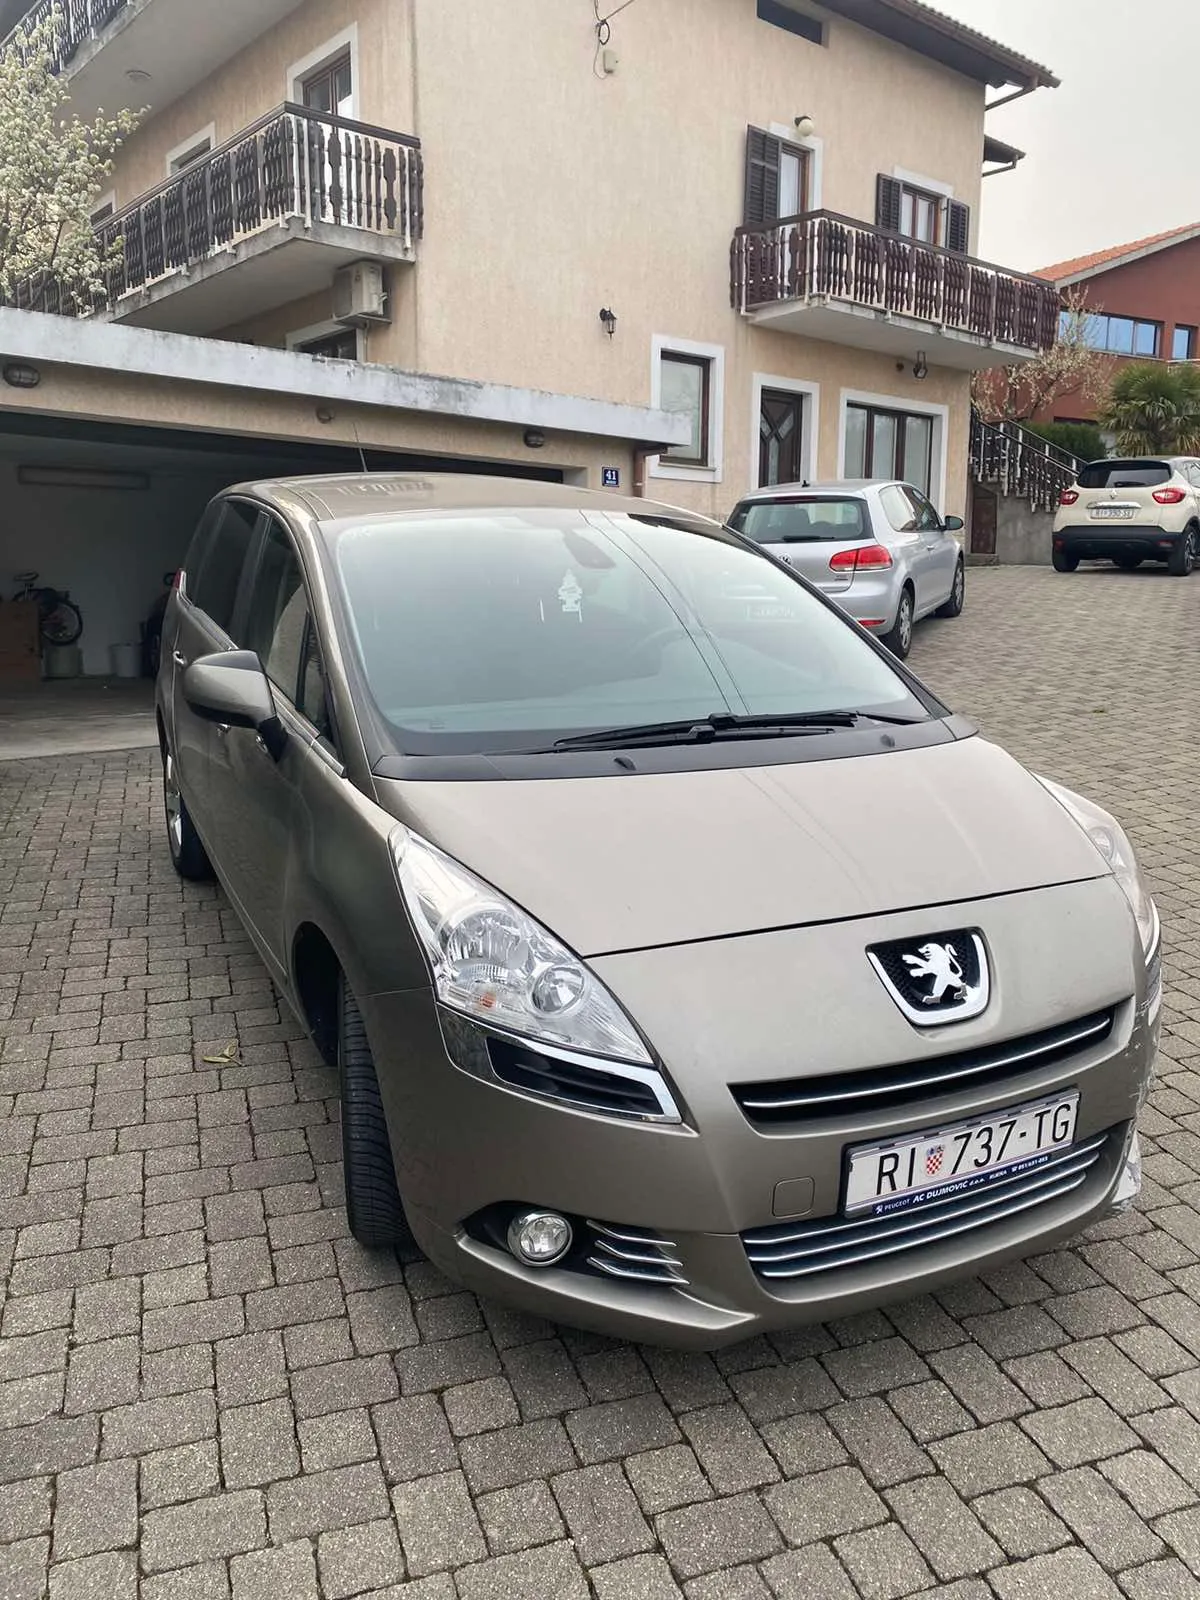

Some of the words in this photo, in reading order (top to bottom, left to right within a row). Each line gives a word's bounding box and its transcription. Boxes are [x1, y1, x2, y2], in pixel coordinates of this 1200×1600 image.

[606, 470, 616, 480] 41
[877, 1147, 916, 1195] RI
[951, 1103, 1071, 1175] 737-TG
[884, 1199, 910, 1211] PEUGEOT
[912, 1193, 926, 1204] AC
